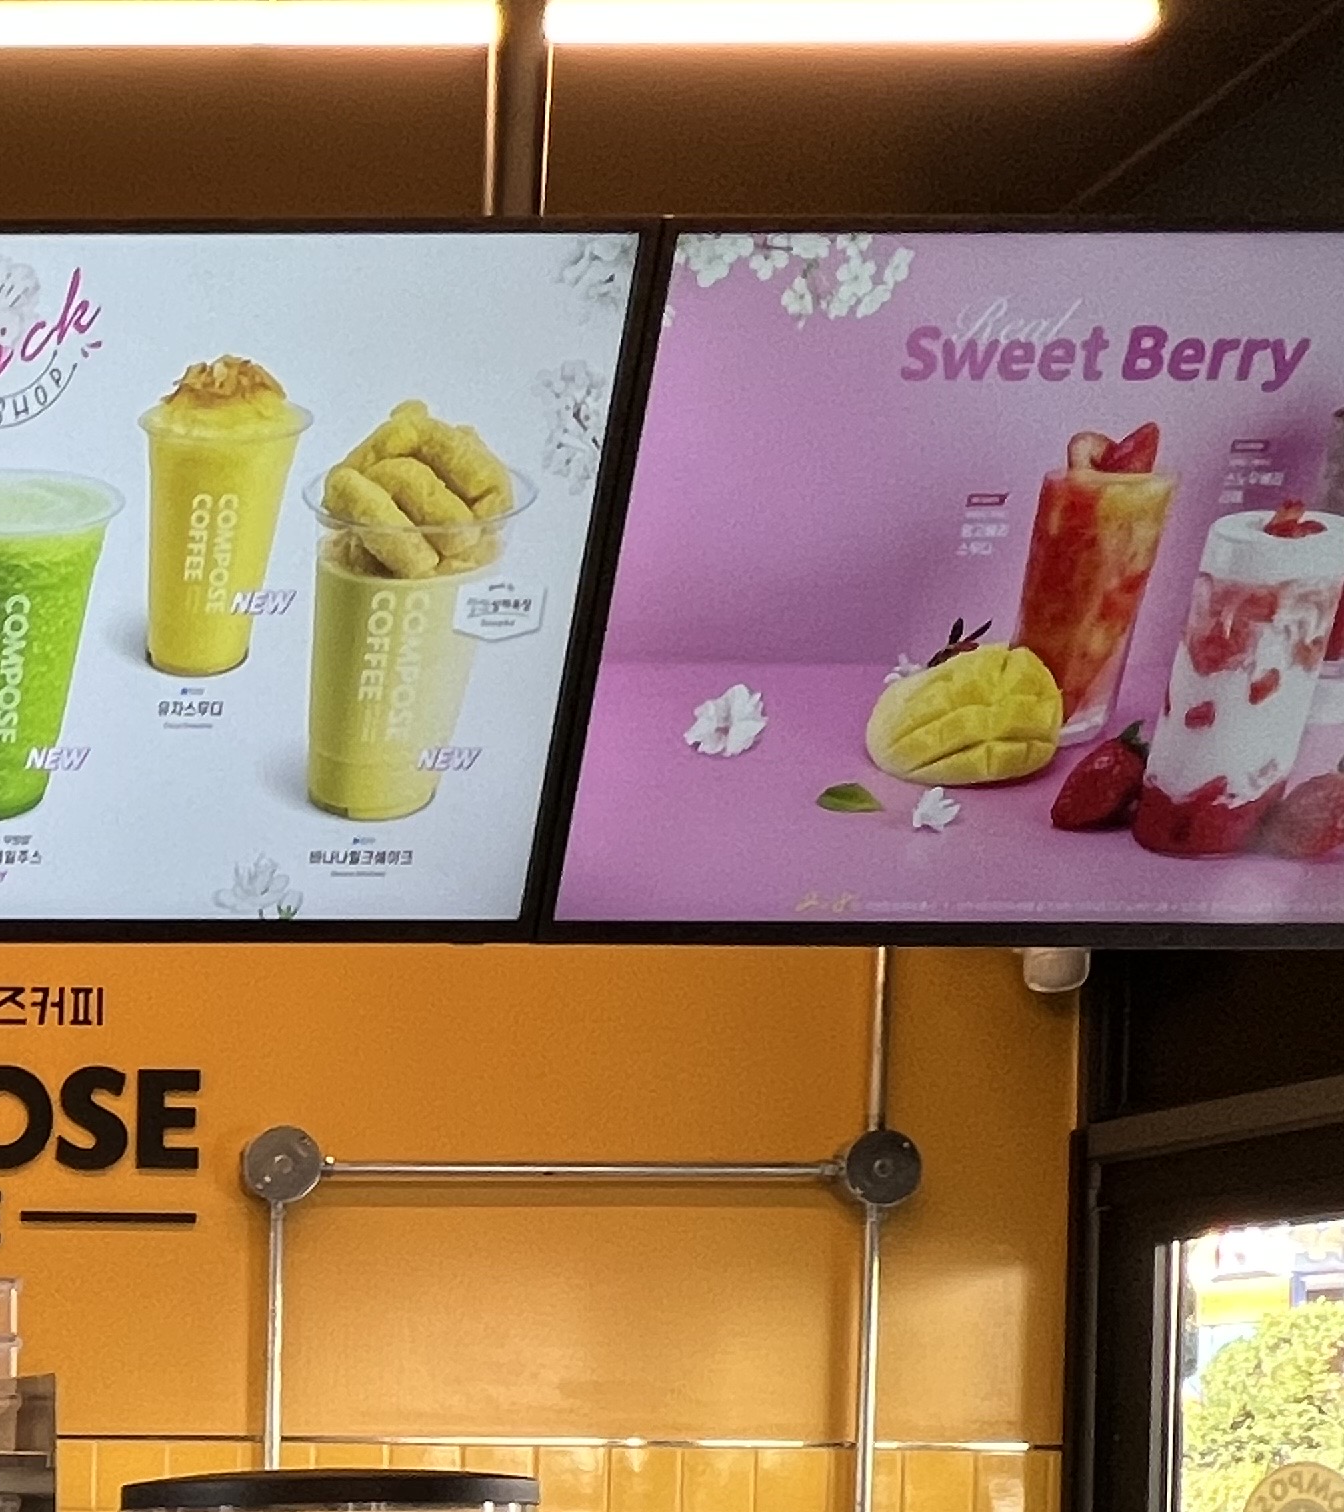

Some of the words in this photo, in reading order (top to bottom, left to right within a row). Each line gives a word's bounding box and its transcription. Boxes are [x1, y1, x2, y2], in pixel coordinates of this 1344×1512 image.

[901, 325, 1109, 382] Sweet
[1122, 325, 1310, 392] Berry
[184, 493, 212, 581] COFFEE
[205, 493, 240, 614] COMPOSE
[229, 589, 297, 615] NEW
[359, 591, 396, 702] COFFEE
[388, 590, 429, 742] COMPOSE
[158, 701, 223, 716] 유자스무디
[24, 746, 91, 771] NEW
[416, 746, 482, 771] NEW
